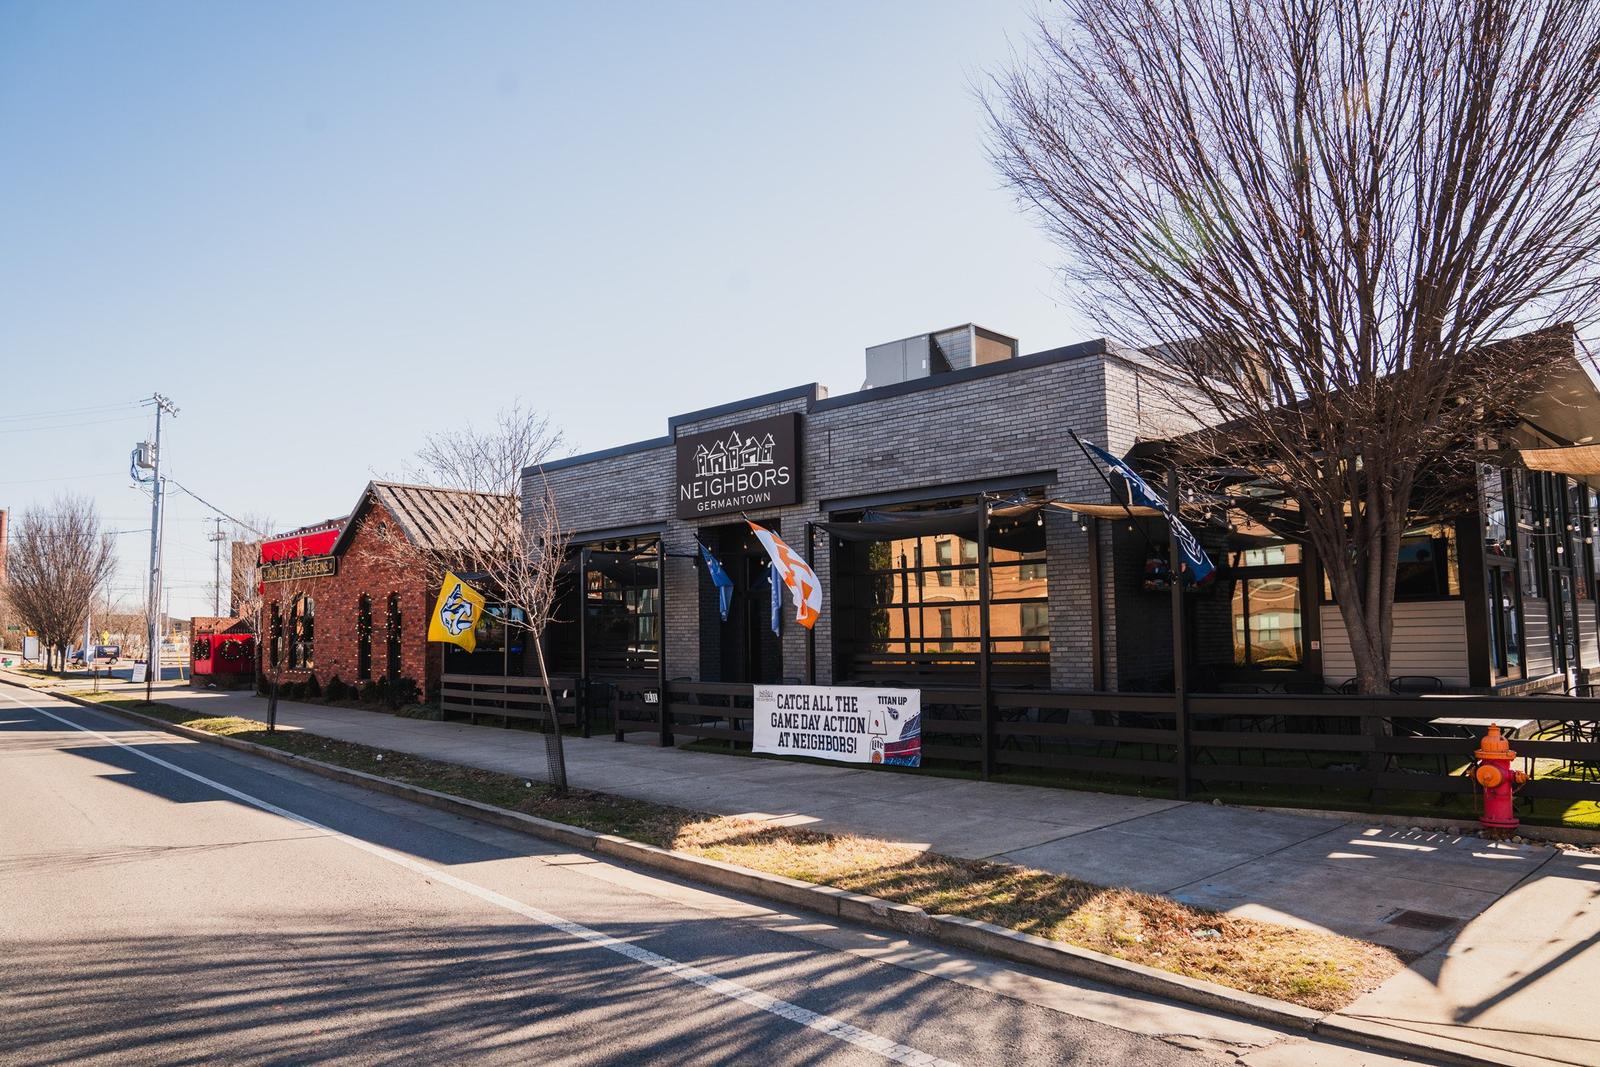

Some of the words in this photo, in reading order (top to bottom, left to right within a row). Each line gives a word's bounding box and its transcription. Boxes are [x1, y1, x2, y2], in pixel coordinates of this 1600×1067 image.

[680, 466, 790, 501] NEIGHBORS
[697, 492, 771, 511] GERMANTOWN
[777, 694, 810, 710] CATCH
[812, 695, 833, 712] ALL
[836, 696, 858, 713] THE
[877, 695, 897, 705] TITAN
[898, 696, 908, 705] UP
[771, 712, 799, 729] GAME
[801, 714, 821, 730] DAY
[823, 715, 866, 734] ACTION
[778, 732, 791, 748] AT
[792, 733, 857, 754] NEIGHBORS!
